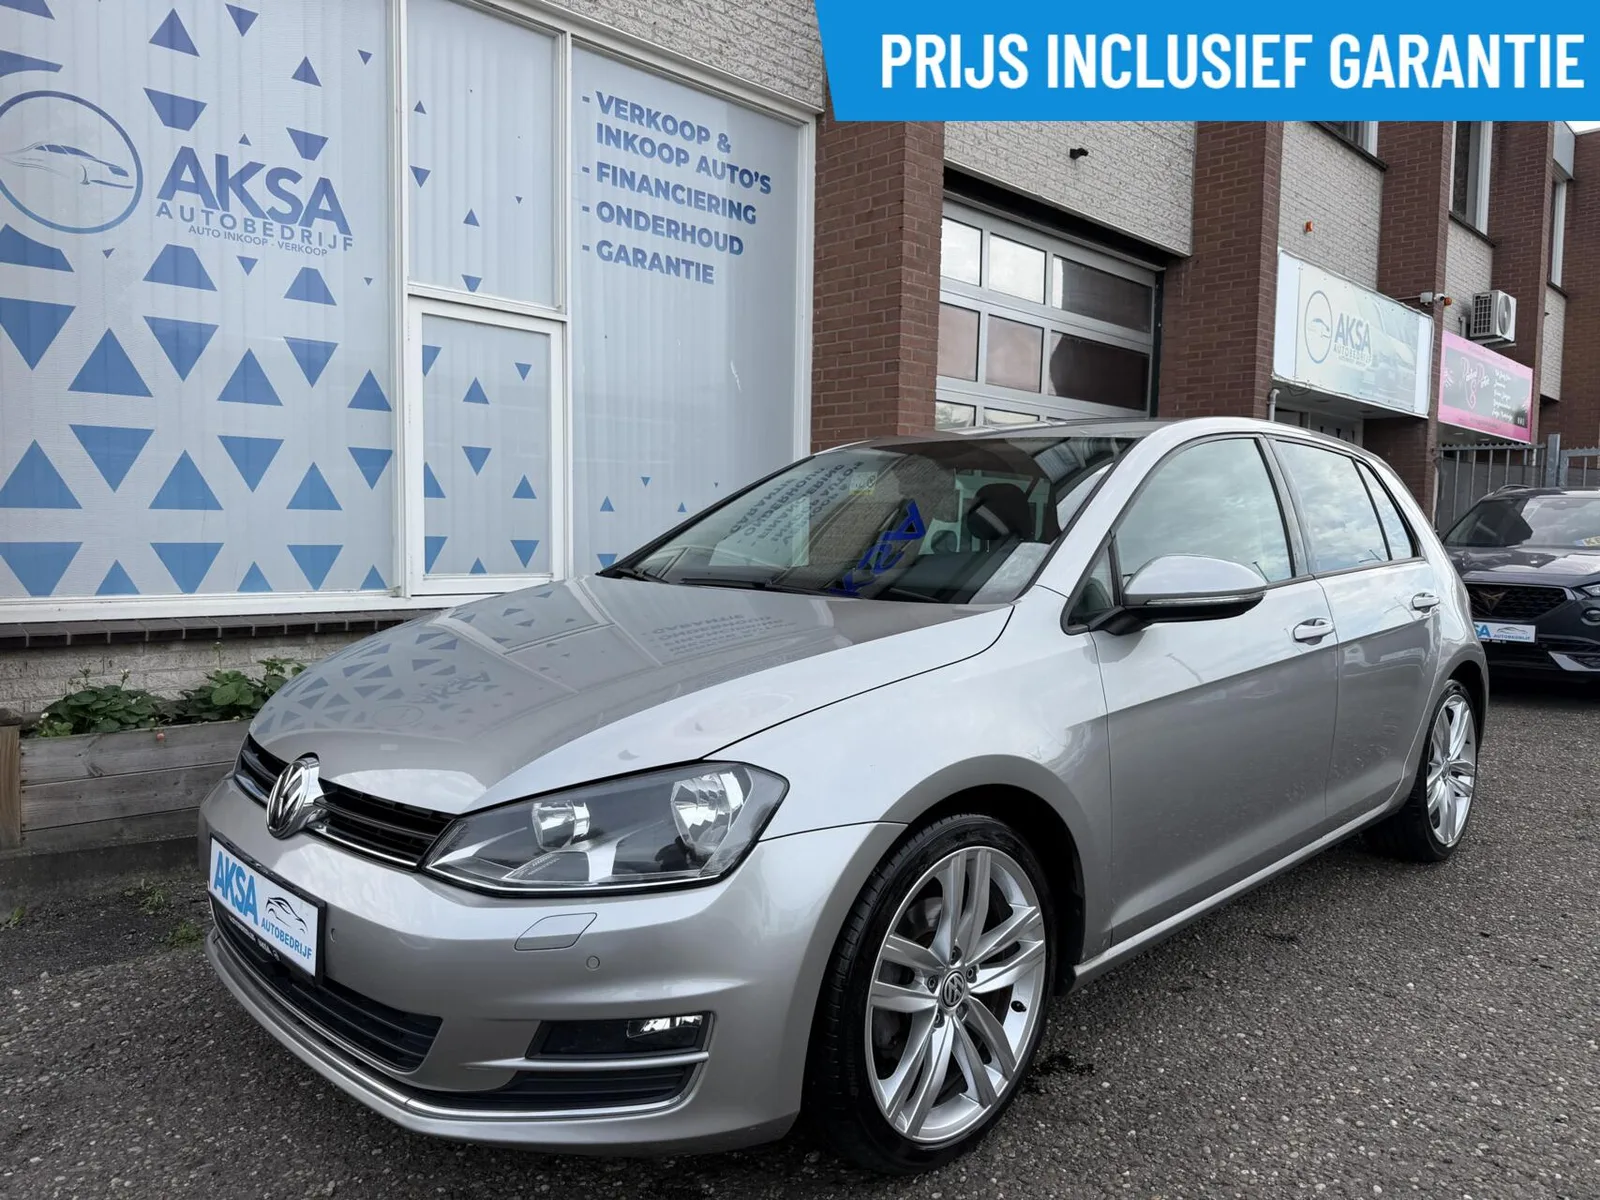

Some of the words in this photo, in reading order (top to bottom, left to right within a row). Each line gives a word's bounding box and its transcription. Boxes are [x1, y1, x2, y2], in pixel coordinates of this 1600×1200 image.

[595, 90, 711, 145] VERKOOP
[717, 132, 732, 154] &
[596, 122, 690, 168] INKOOP
[695, 155, 772, 195] AUTO'S
[156, 145, 353, 237] AKSA
[596, 161, 757, 225] FINANCIERING
[155, 201, 354, 252] AUTOBEDRIJF
[188, 224, 221, 239] AUTO
[223, 230, 269, 247] INKOOP
[277, 240, 328, 258] VERKOOP
[595, 200, 744, 256] ONDERHOUD
[596, 239, 715, 285] GARANTIE
[1334, 312, 1372, 356] AKSA
[213, 850, 259, 926] AKSA
[260, 917, 313, 960] AUTOBEDRIJF
